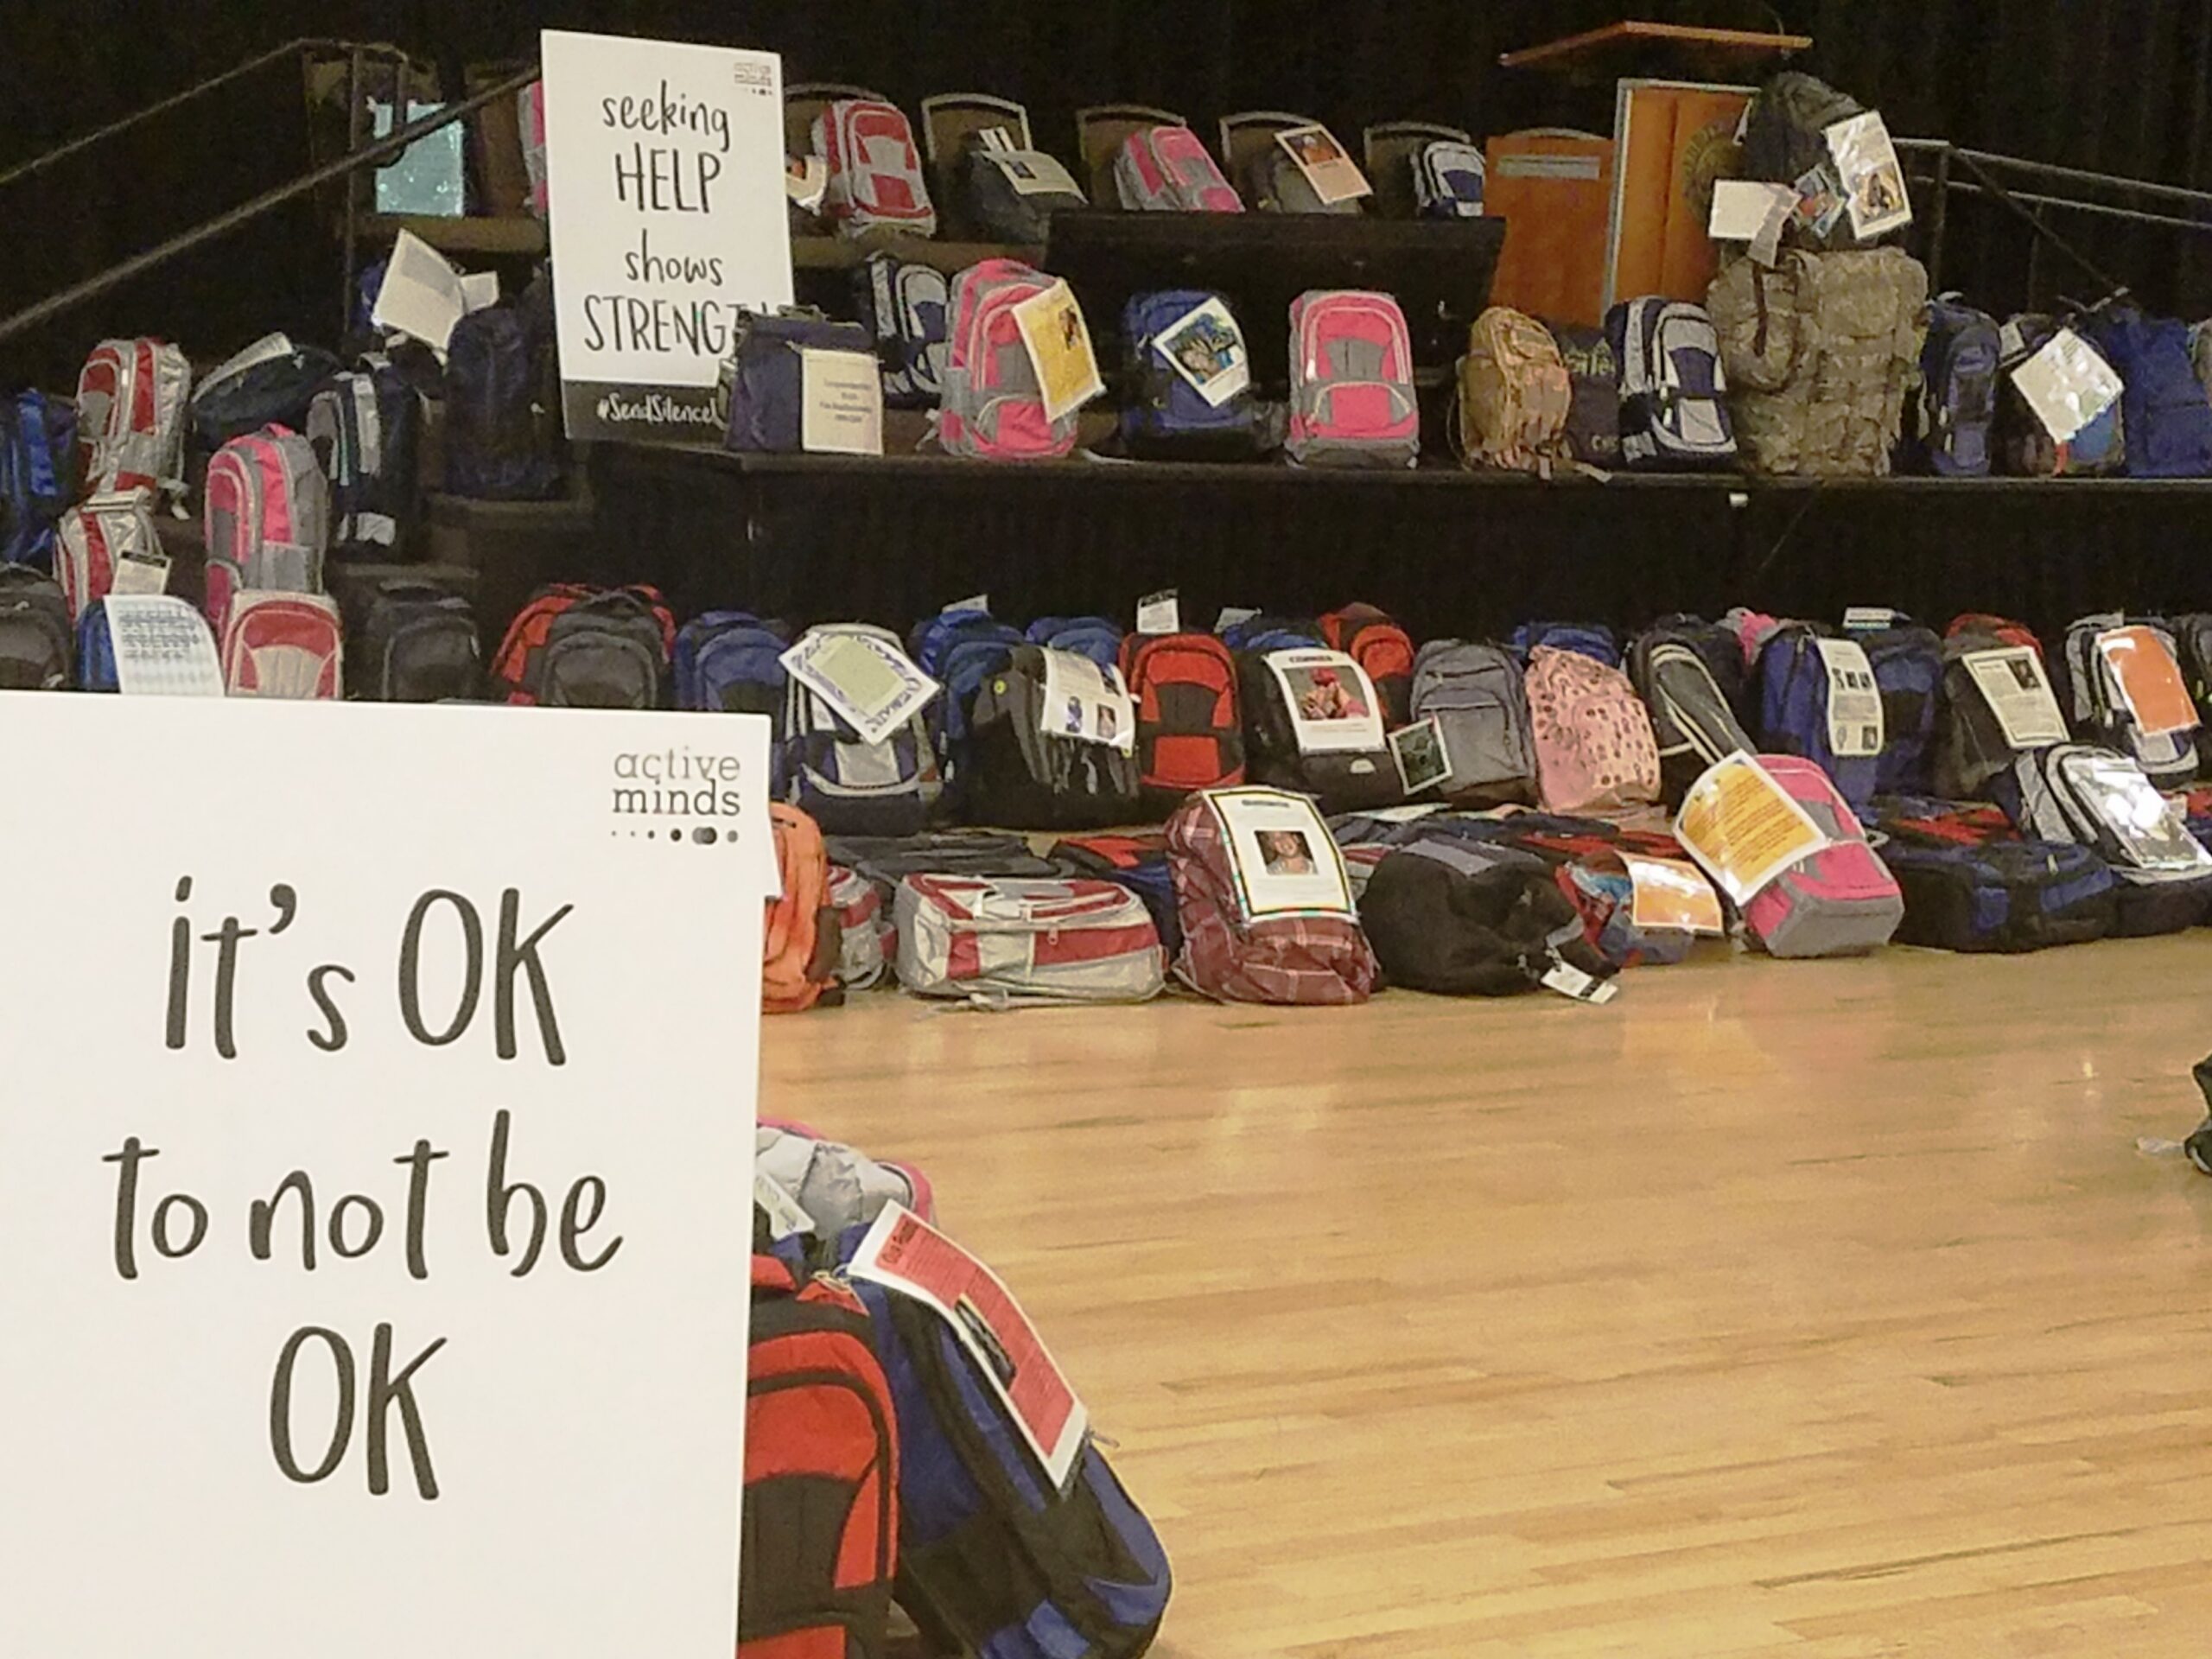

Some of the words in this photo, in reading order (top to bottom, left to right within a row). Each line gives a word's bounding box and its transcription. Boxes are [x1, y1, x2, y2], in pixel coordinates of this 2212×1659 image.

[602, 79, 731, 152] seeking
[615, 143, 721, 213] HELP
[626, 228, 723, 286] shows
[584, 295, 768, 356] STRENG
[613, 745, 741, 781] active
[613, 778, 741, 817] minds
[166, 875, 355, 1059] it’s
[398, 887, 574, 1066] OK
[102, 1136, 208, 1281] to
[249, 1139, 449, 1280] not
[486, 1109, 623, 1278] be
[270, 1322, 447, 1501] OK
